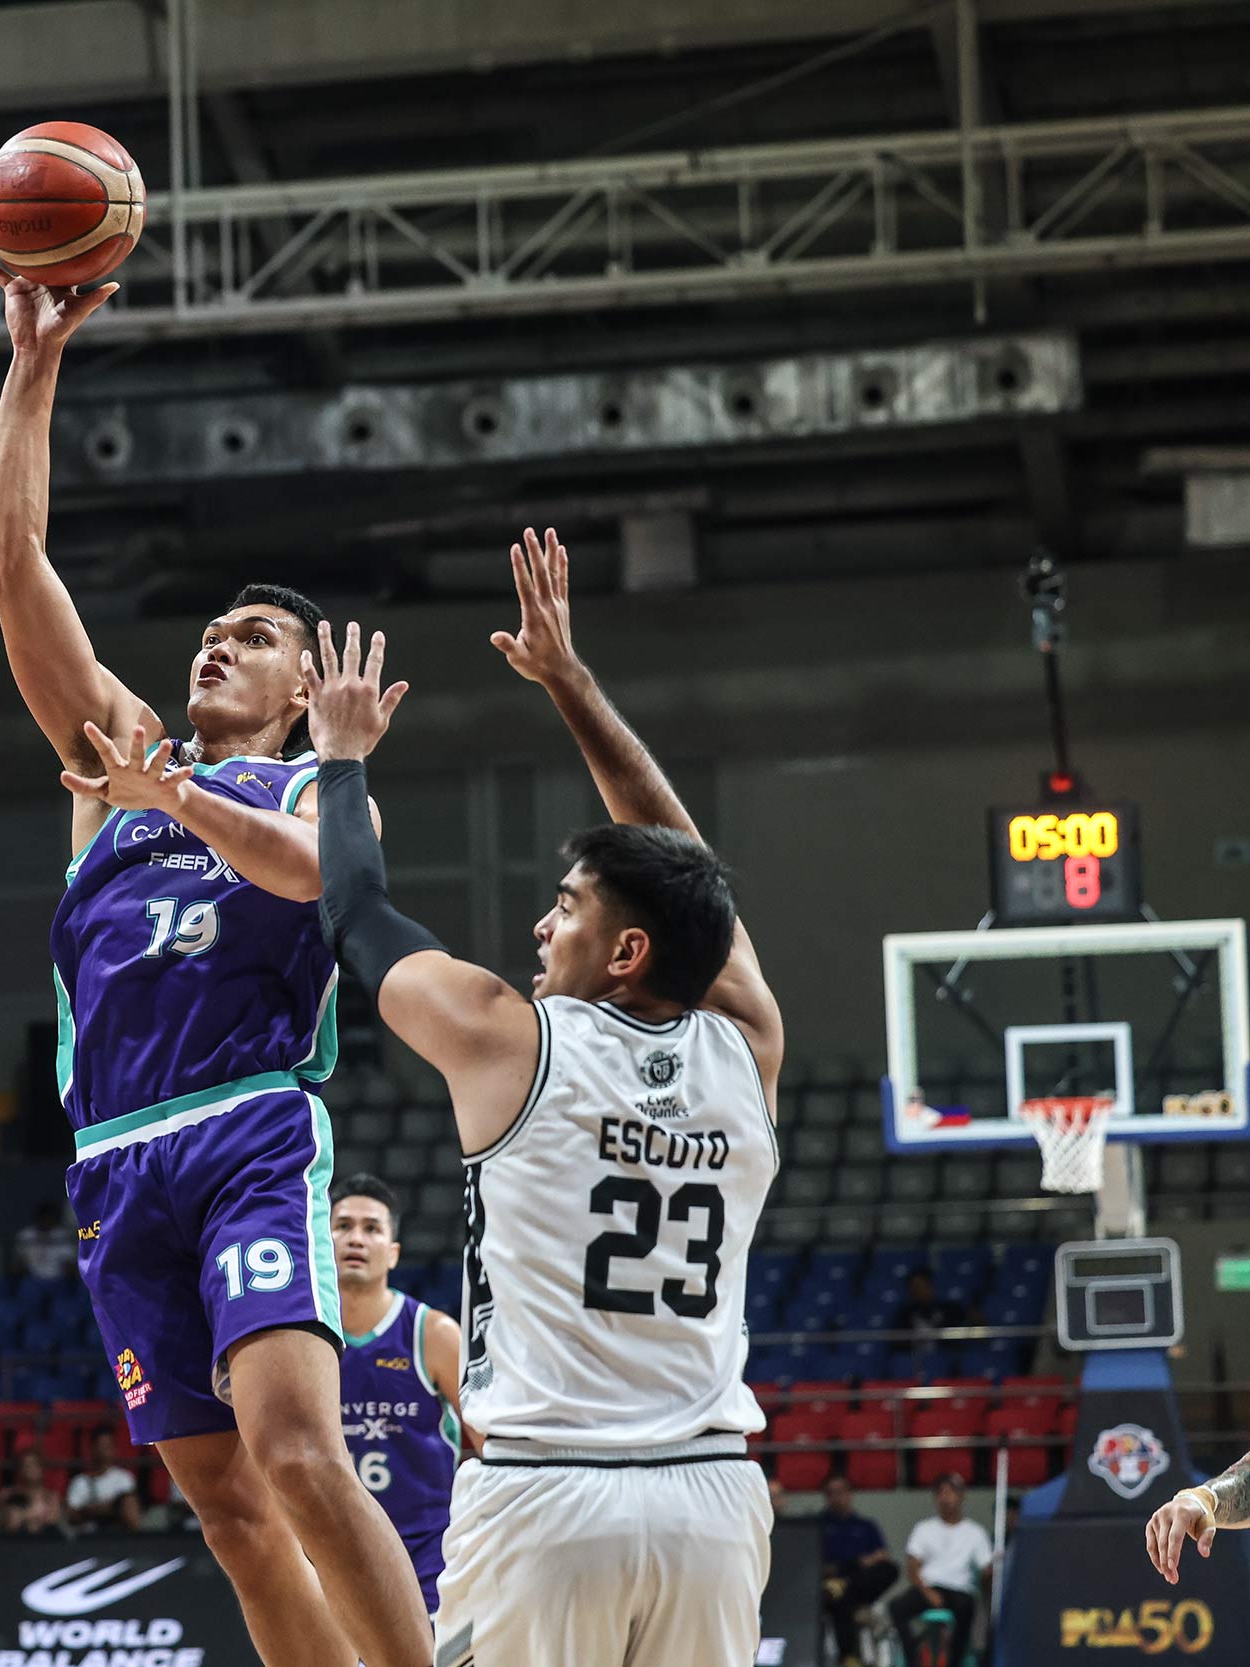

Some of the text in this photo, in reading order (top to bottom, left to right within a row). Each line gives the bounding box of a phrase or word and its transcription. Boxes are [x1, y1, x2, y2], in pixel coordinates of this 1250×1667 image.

[1009, 812, 1118, 861] 05:00
[1065, 854, 1100, 908] 8
[143, 897, 220, 958] 19
[599, 1117, 729, 1170] ESCOTO
[215, 1238, 295, 1301] 19
[583, 1175, 725, 1319] 23
[341, 1401, 419, 1416] NVERGE
[352, 1451, 391, 1491] 6
[19, 1618, 184, 1650] WORLD
